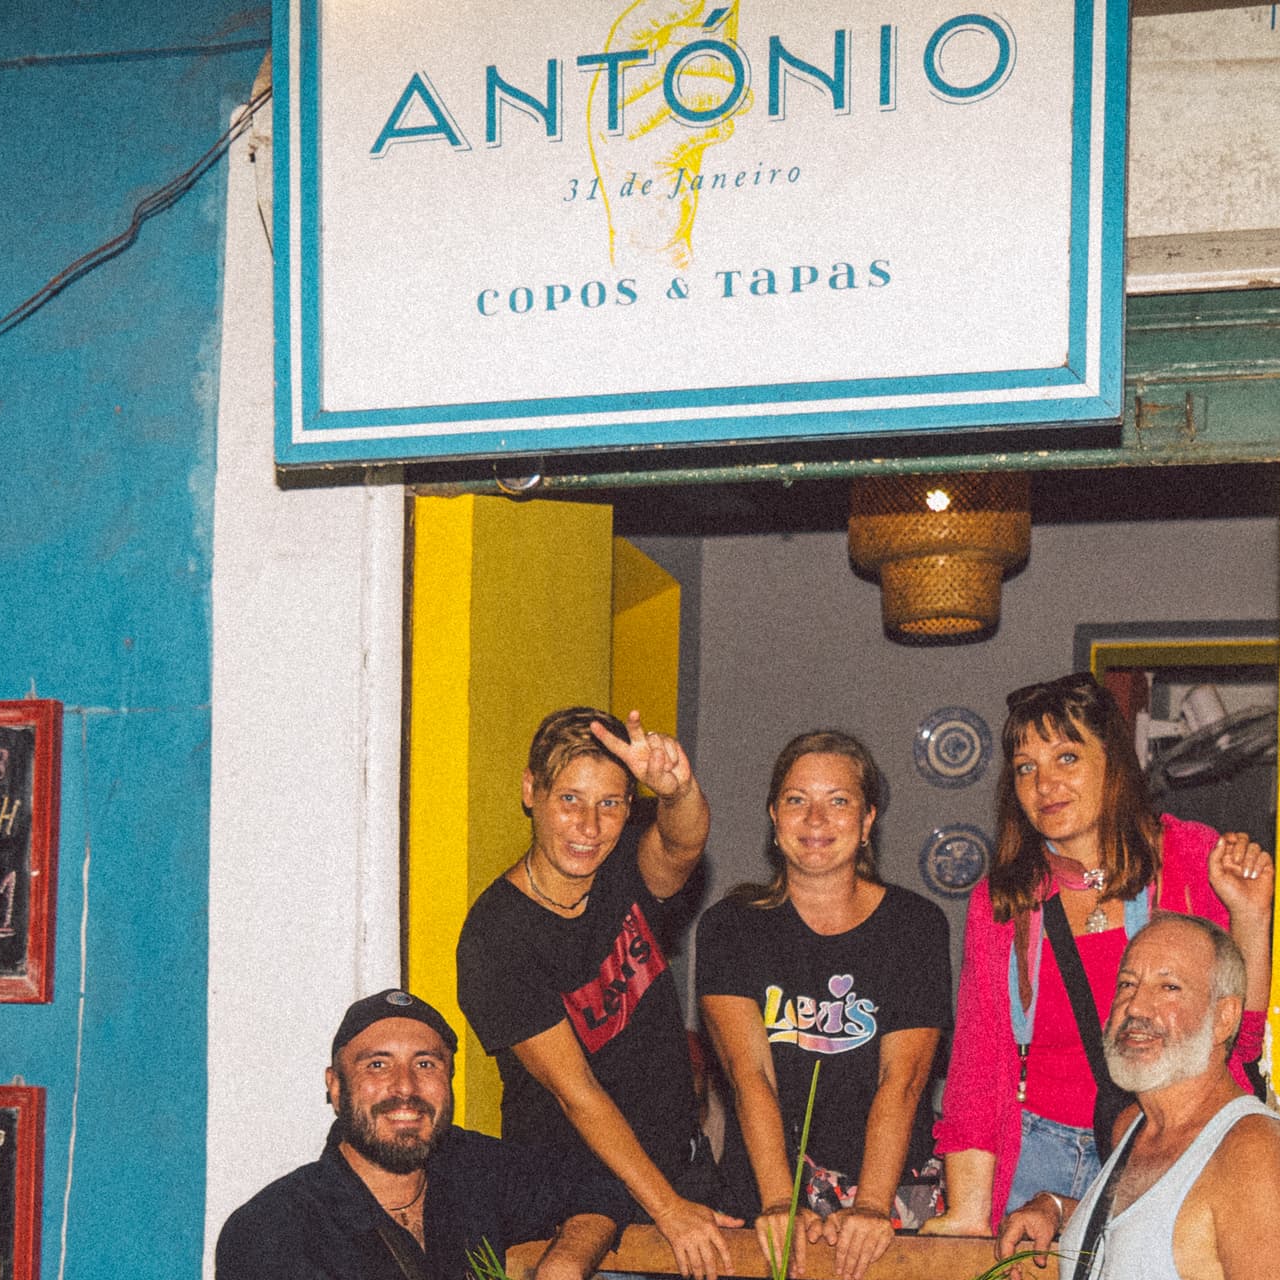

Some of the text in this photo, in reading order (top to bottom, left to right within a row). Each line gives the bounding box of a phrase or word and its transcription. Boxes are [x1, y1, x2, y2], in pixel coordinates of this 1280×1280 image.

[370, 8, 1017, 159] ANTÓNIO
[563, 163, 803, 202] 31 de Janeiro
[476, 277, 640, 317] COPOS
[666, 278, 691, 301] &
[582, 934, 652, 1031] Levis
